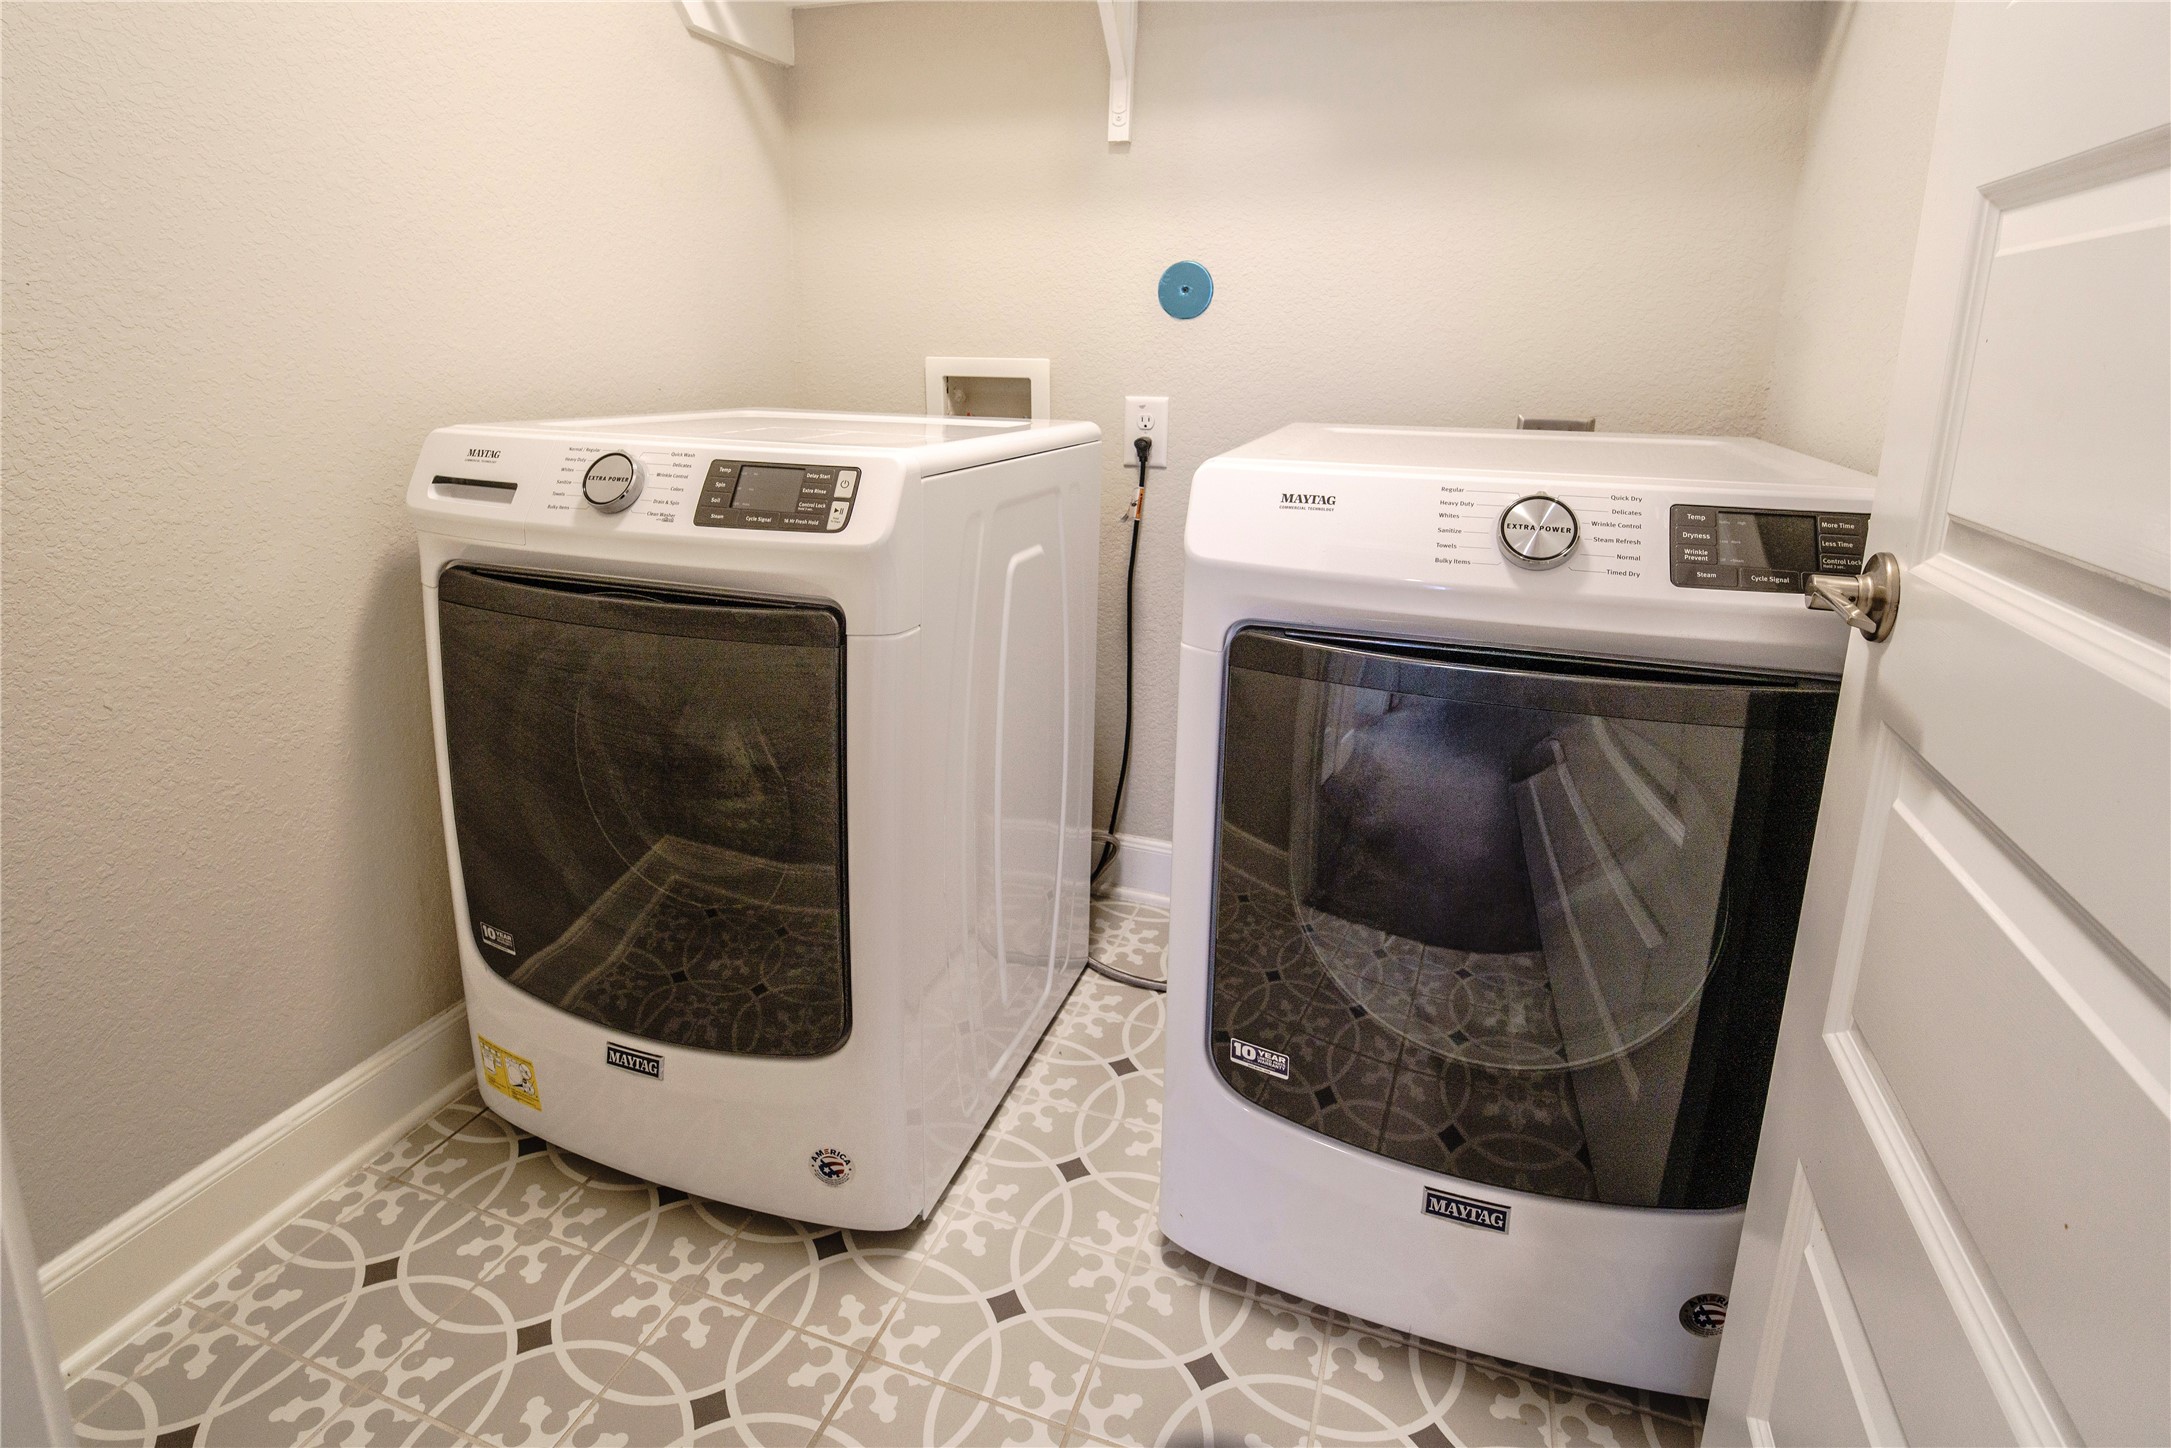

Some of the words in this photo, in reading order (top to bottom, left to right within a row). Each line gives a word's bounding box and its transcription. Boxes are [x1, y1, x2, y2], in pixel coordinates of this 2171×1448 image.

[466, 448, 501, 459] MAYTAG
[1281, 493, 1336, 505] MAYTAG
[1687, 513, 1706, 521] Temp
[1506, 522, 1536, 531] EXTRA
[1539, 525, 1572, 534] POWER
[1628, 570, 1640, 578] Dry
[1751, 575, 1768, 583] Cycle
[1769, 576, 1790, 584] Signal
[482, 925, 496, 940] 10
[1234, 1042, 1256, 1060] 10
[1258, 1050, 1286, 1064] YEAR
[608, 1050, 658, 1075] MAYTAG
[811, 1148, 851, 1166] AMERICA
[1428, 1196, 1504, 1228] MAYTAG
